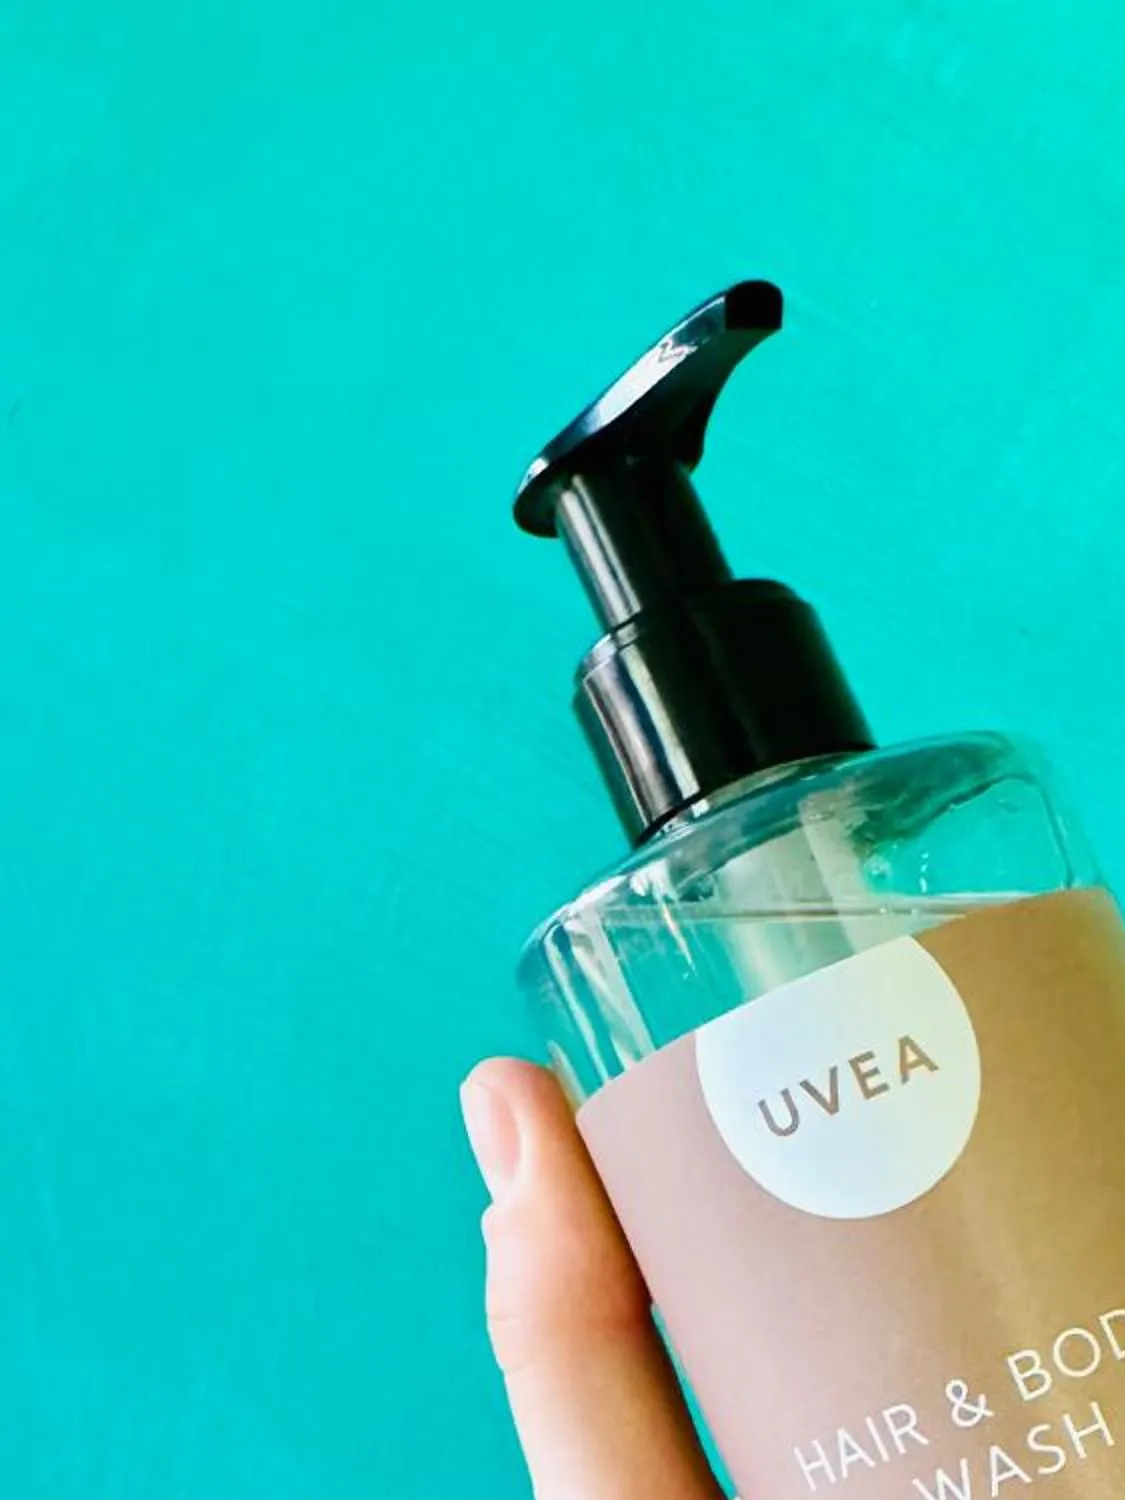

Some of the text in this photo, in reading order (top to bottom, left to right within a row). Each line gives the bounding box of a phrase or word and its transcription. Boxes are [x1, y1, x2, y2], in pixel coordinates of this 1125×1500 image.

[758, 1034, 938, 1137] UVEA
[793, 1402, 928, 1491] HAIR
[945, 1379, 993, 1429] &
